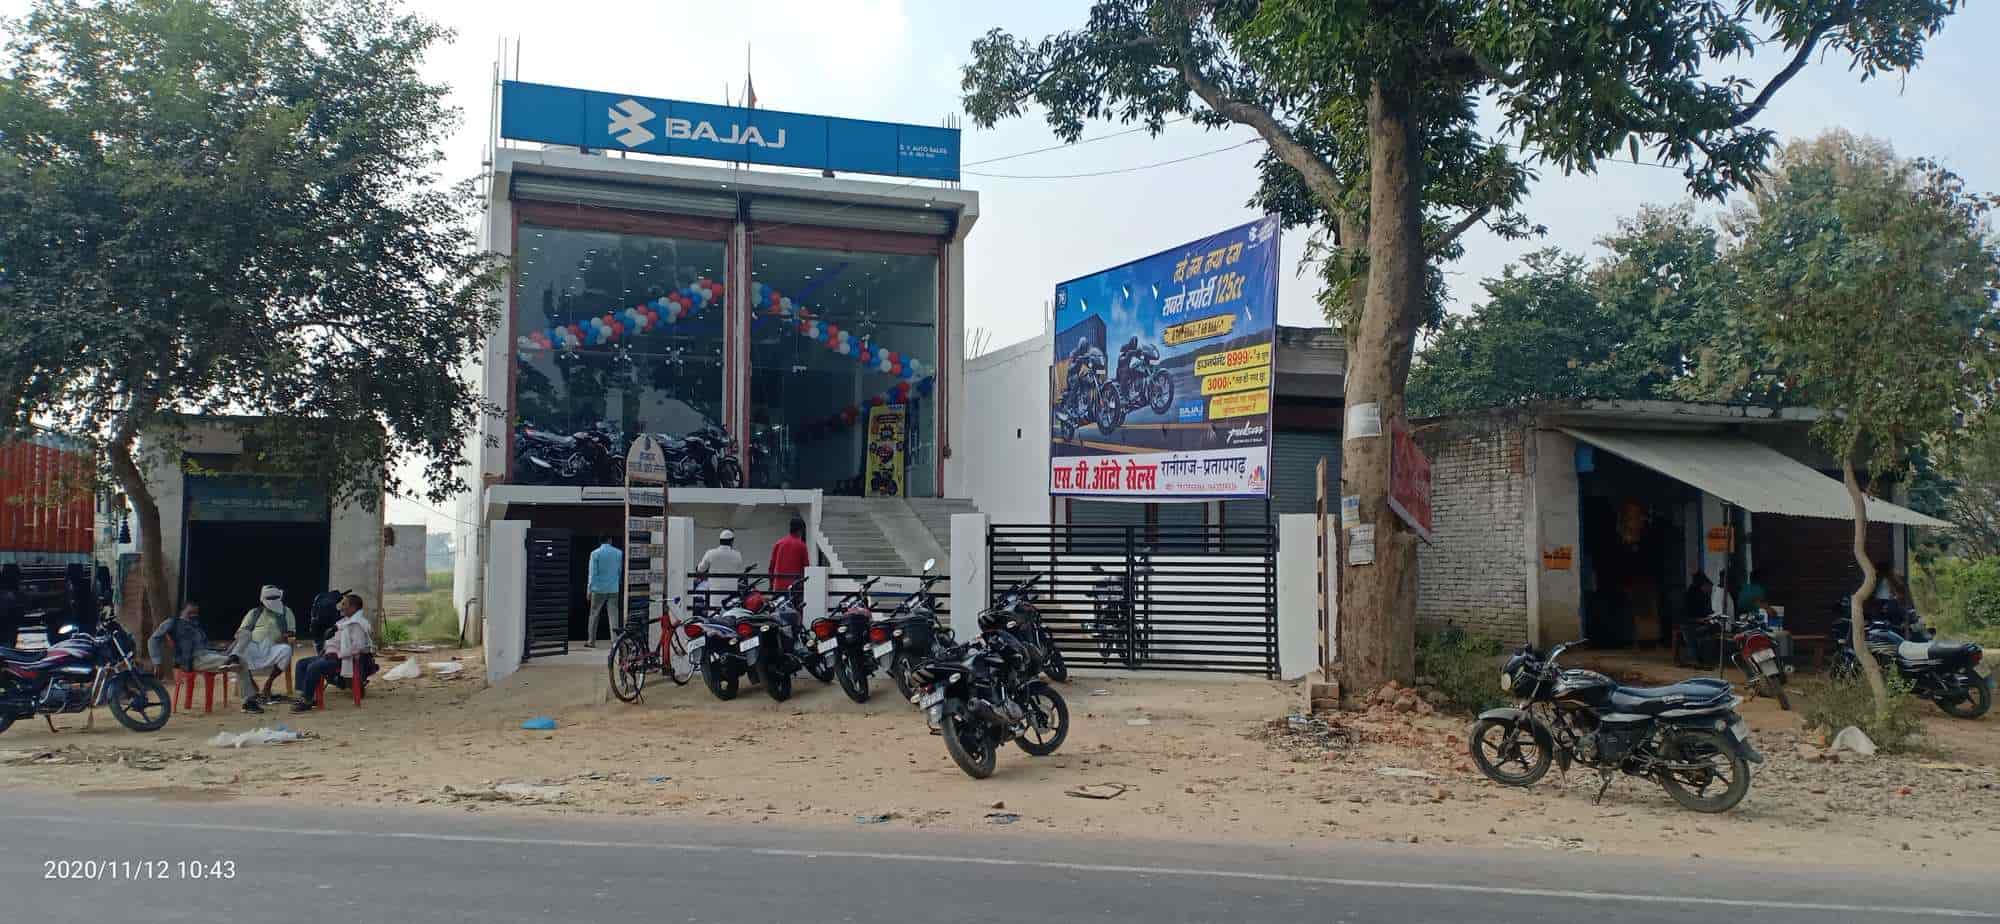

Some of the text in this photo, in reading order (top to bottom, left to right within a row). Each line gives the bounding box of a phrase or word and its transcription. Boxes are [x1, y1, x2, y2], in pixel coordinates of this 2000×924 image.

[665, 118, 786, 148] BAJAJ
[1162, 284, 1186, 316] सबसे
[1126, 459, 1158, 490] सेल्स
